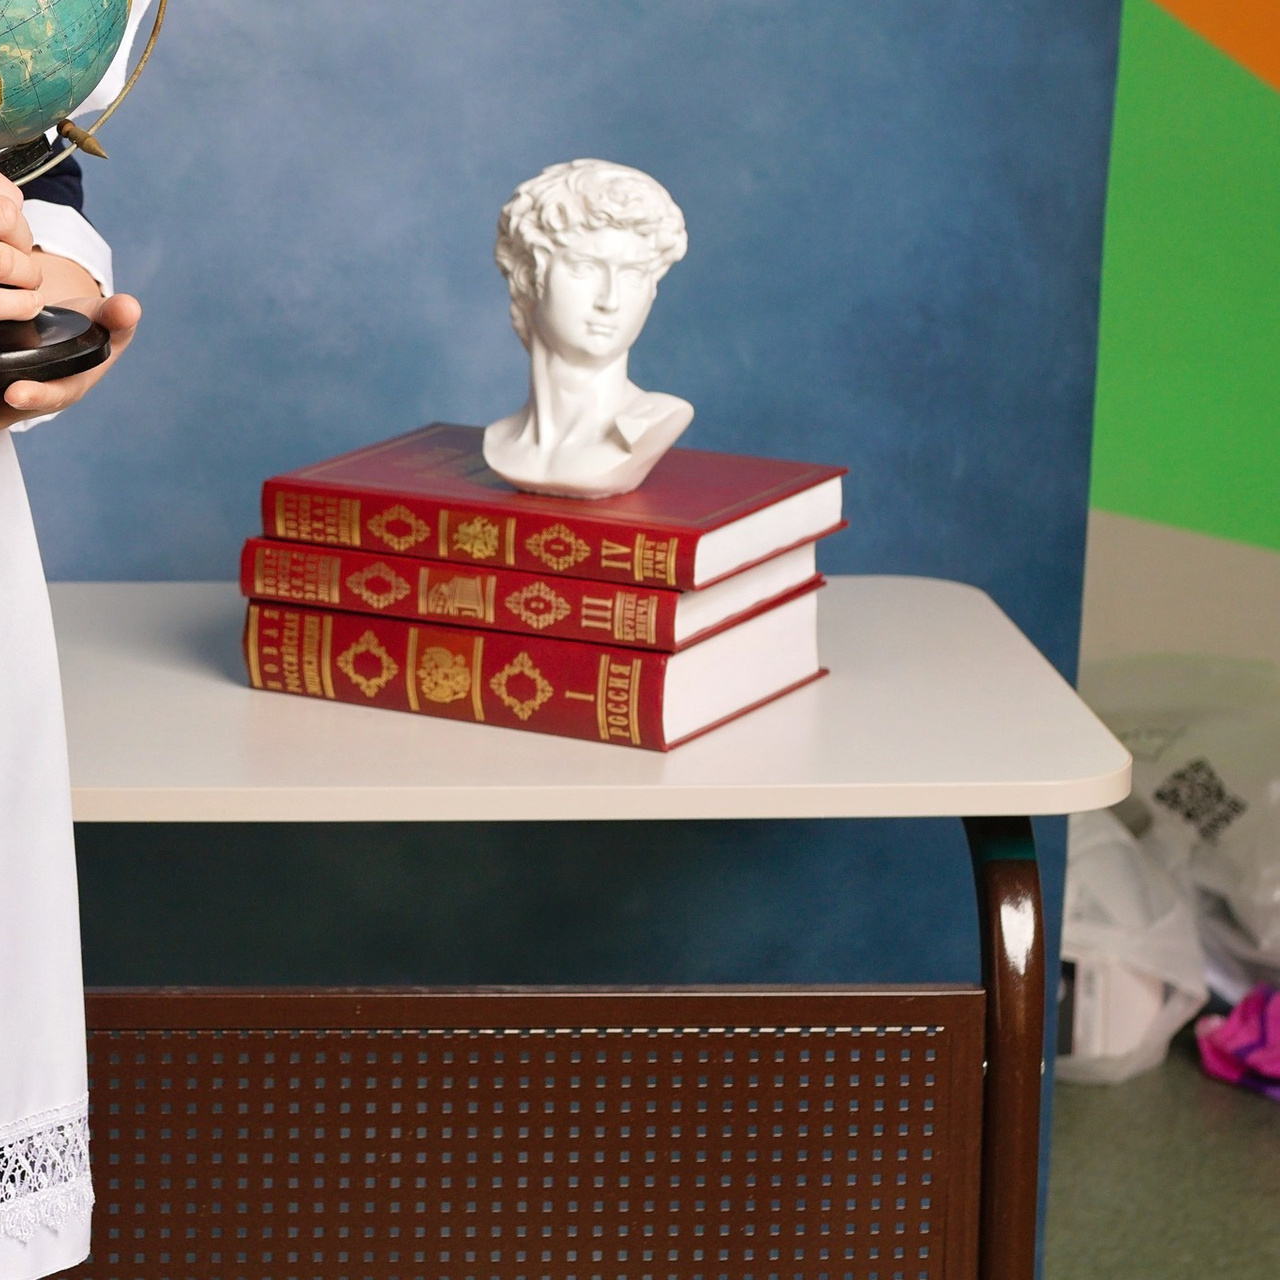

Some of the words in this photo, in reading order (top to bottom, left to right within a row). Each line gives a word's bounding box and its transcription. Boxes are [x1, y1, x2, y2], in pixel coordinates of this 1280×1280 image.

[601, 538, 631, 571] IV
[581, 595, 612, 631] III
[565, 690, 595, 702] I
[607, 663, 631, 738] РОССИЯ
